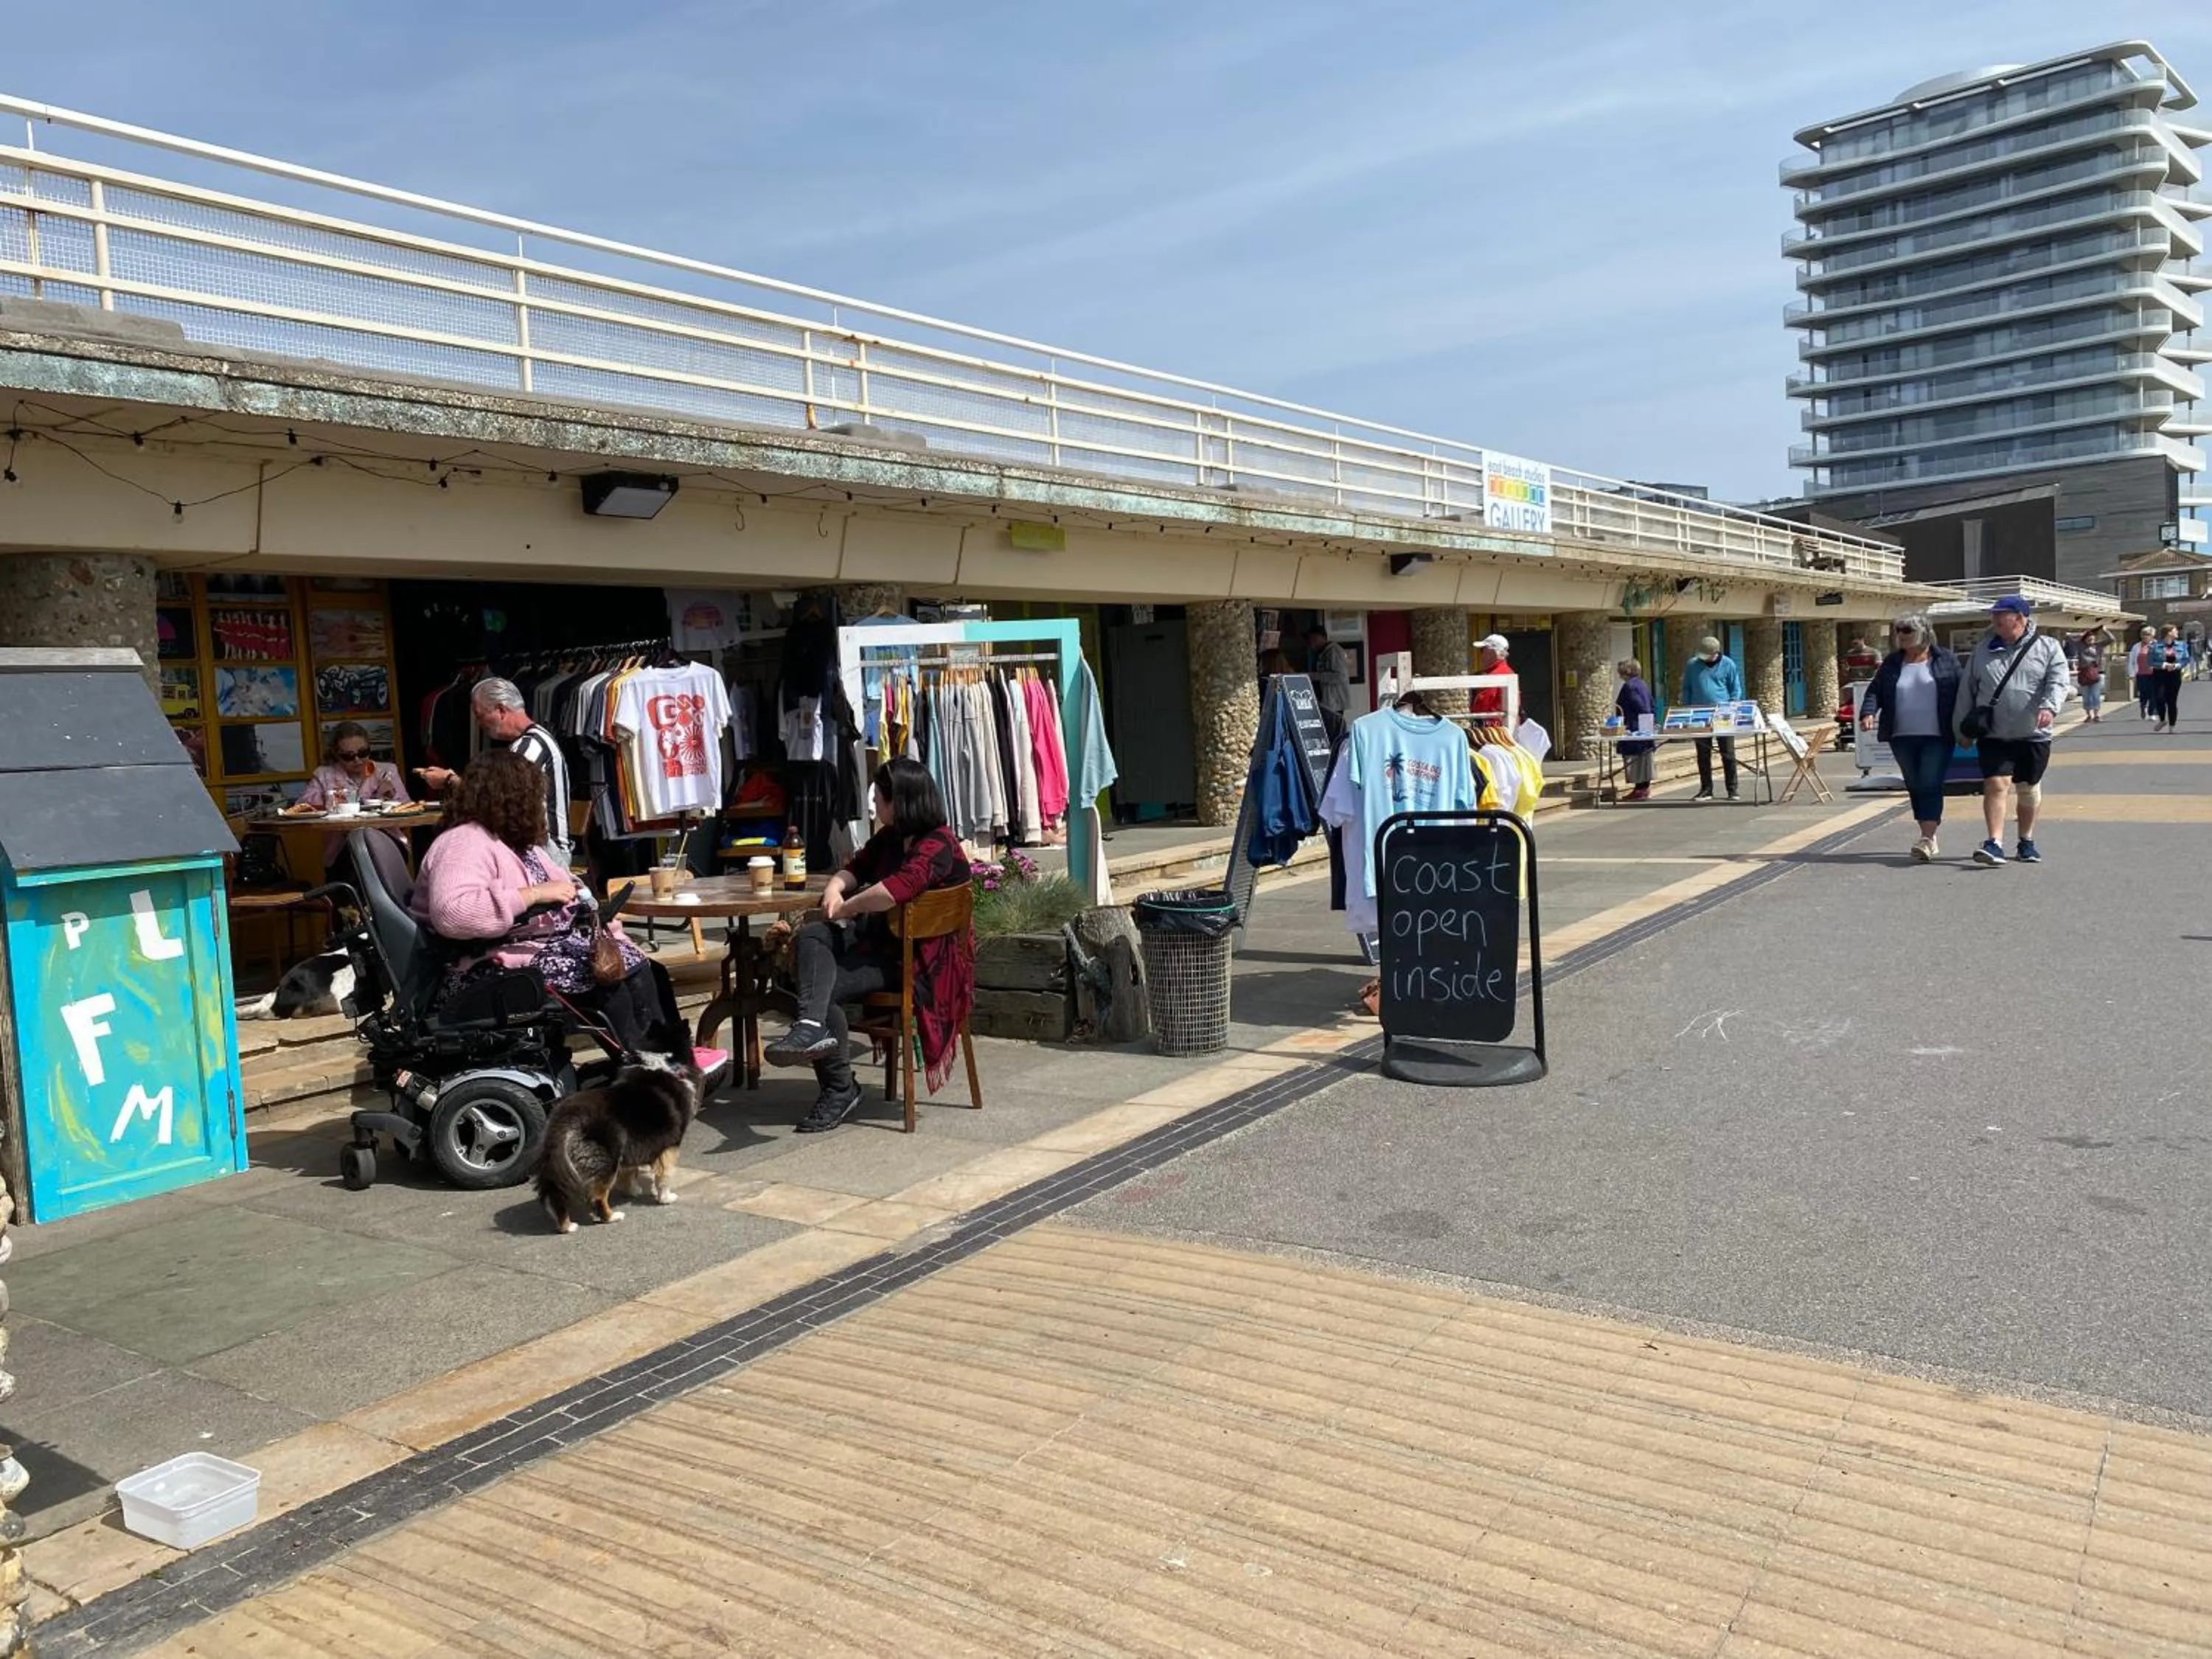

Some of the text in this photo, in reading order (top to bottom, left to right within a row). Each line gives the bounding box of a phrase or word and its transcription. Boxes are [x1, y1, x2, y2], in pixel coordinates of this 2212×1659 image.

[1490, 502, 1545, 532] GALLERY
[1392, 908, 1487, 956] open
[1392, 951, 1507, 1003] inside
